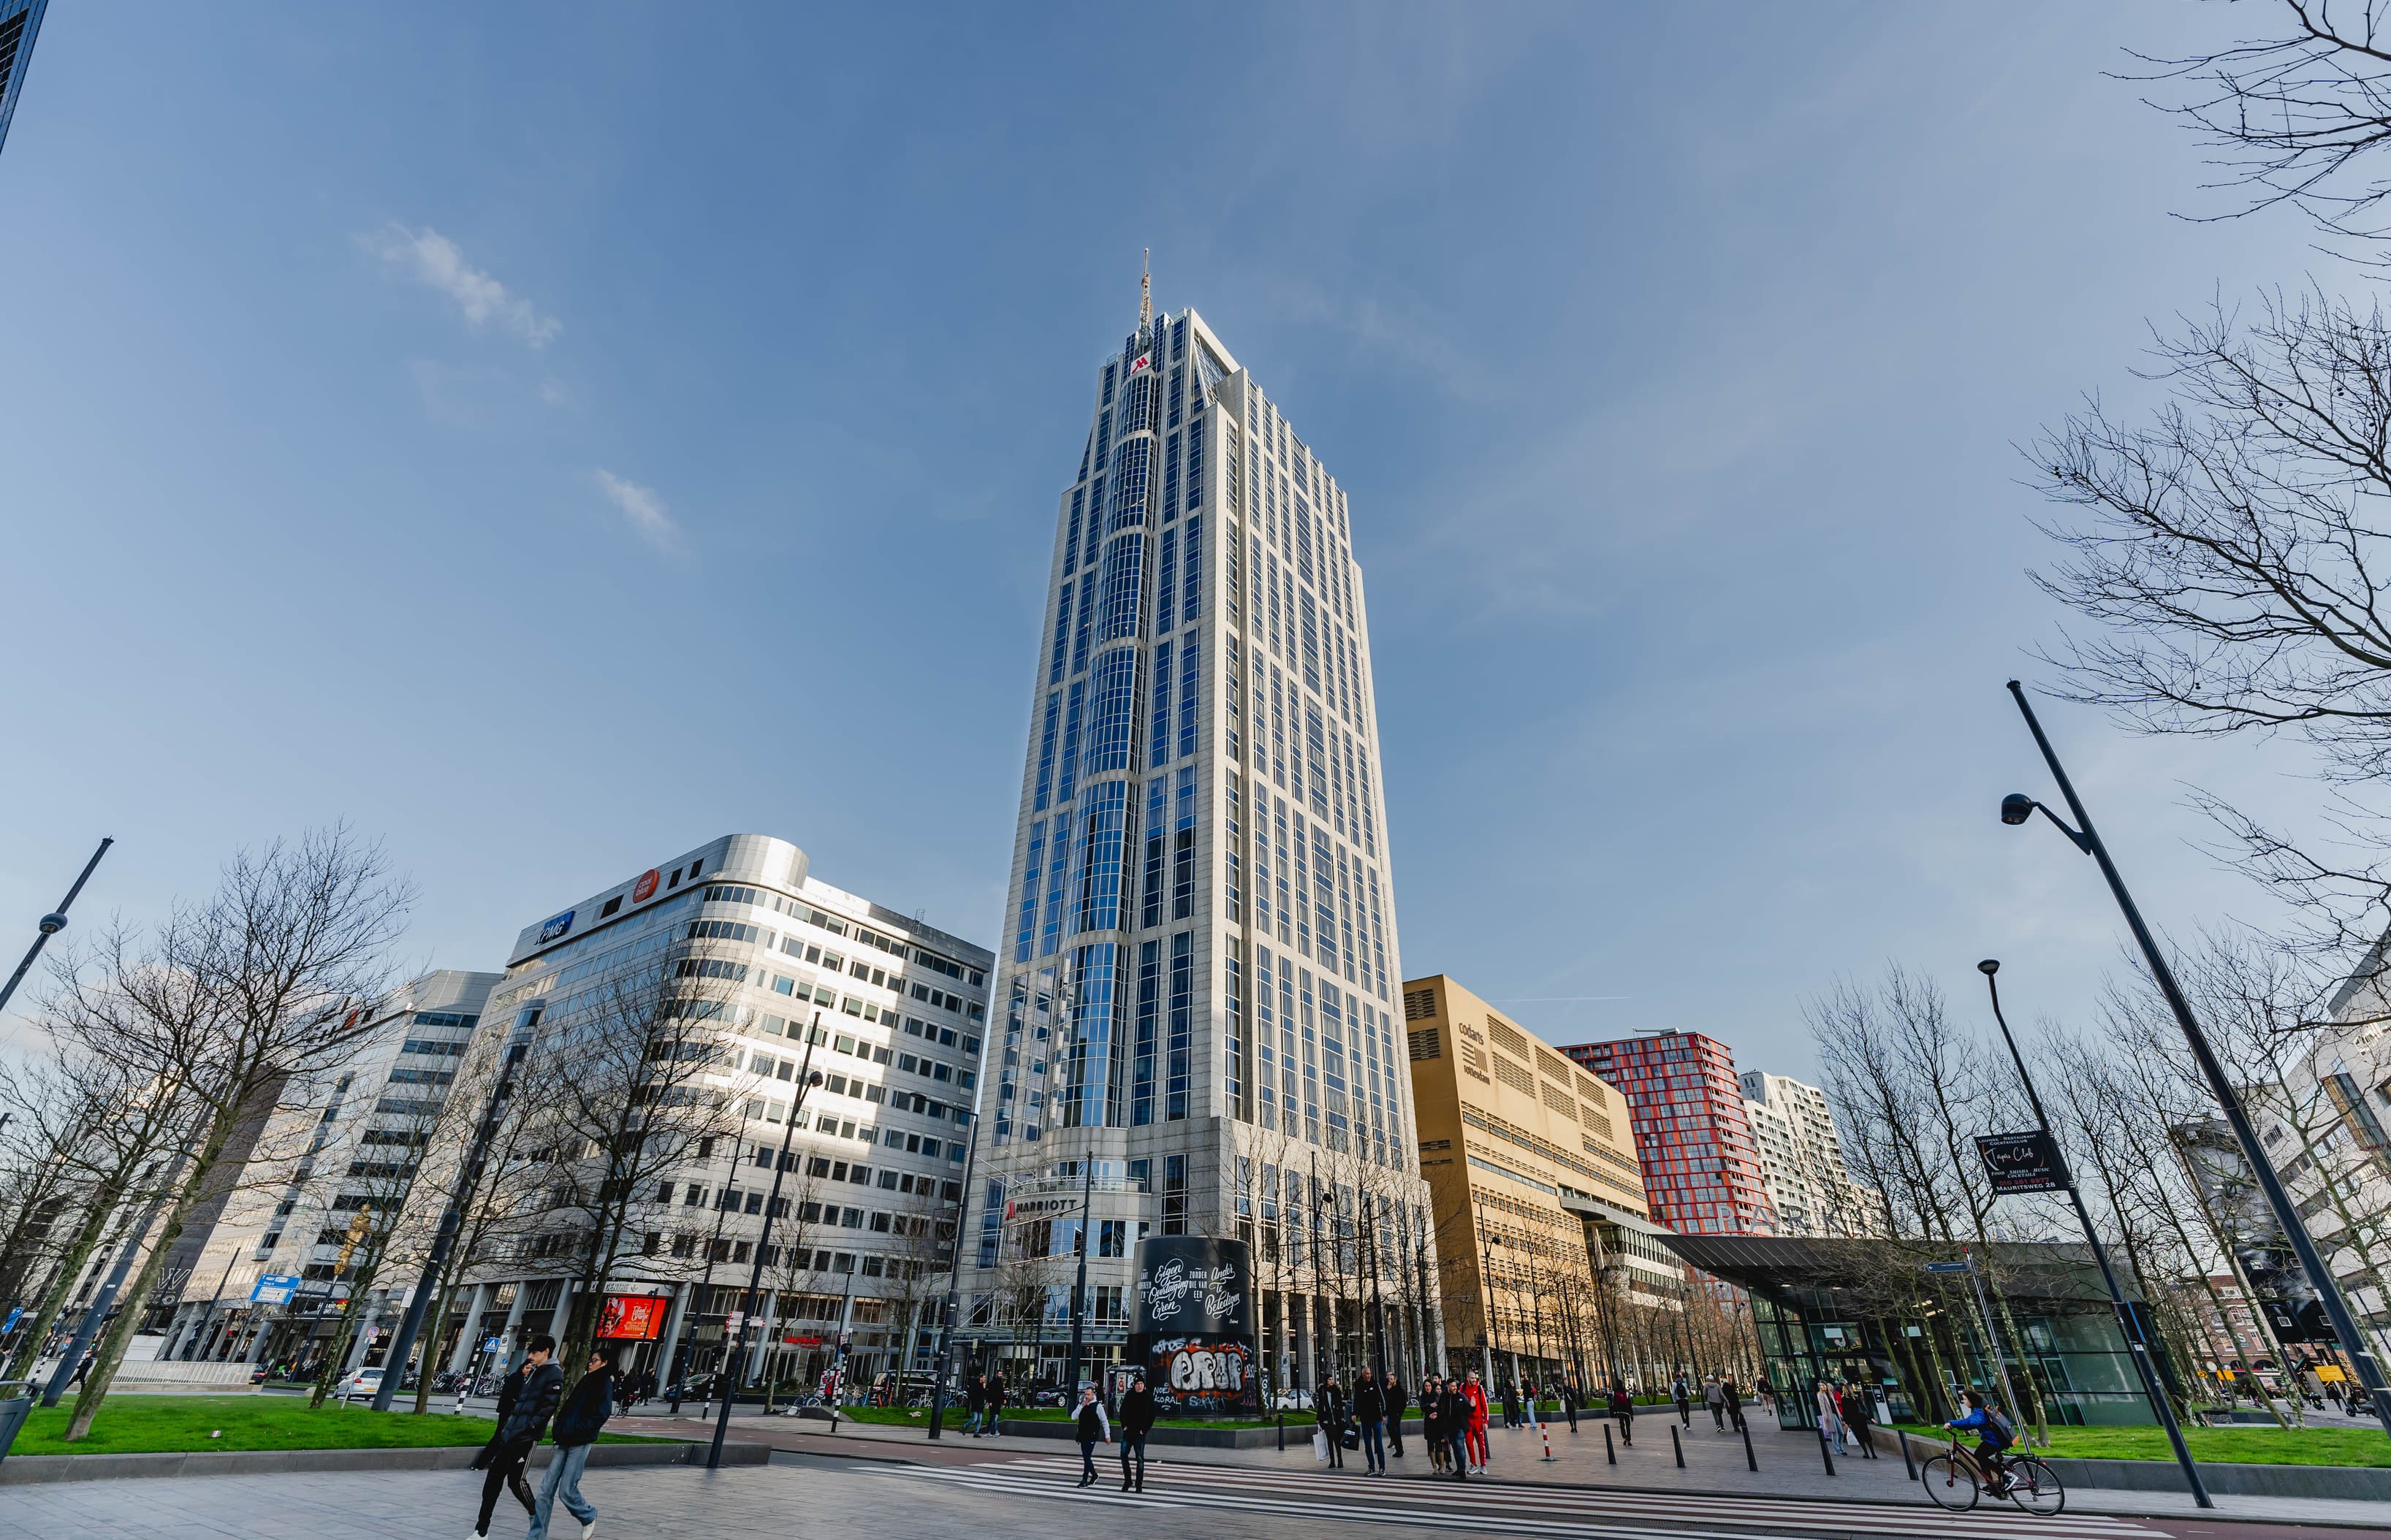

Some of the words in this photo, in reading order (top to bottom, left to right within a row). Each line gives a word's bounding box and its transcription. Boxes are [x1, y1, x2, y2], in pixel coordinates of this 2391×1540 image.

[535, 920, 565, 944] KPMG
[1459, 1023, 1484, 1045] codarts
[2012, 1146, 2034, 1161] Club
[1996, 1183, 2044, 1192] MAURITSWEG
[1016, 1200, 1076, 1213] MARRIOTT
[1155, 1258, 1184, 1286] Eigen
[1211, 1263, 1236, 1281] Ander
[1189, 1281, 1197, 1289] DIE
[1198, 1281, 1208, 1289] VAN
[1193, 1290, 1203, 1298] EEN
[1152, 1300, 1181, 1321] Eren
[1206, 1291, 1240, 1319] Beledigen
